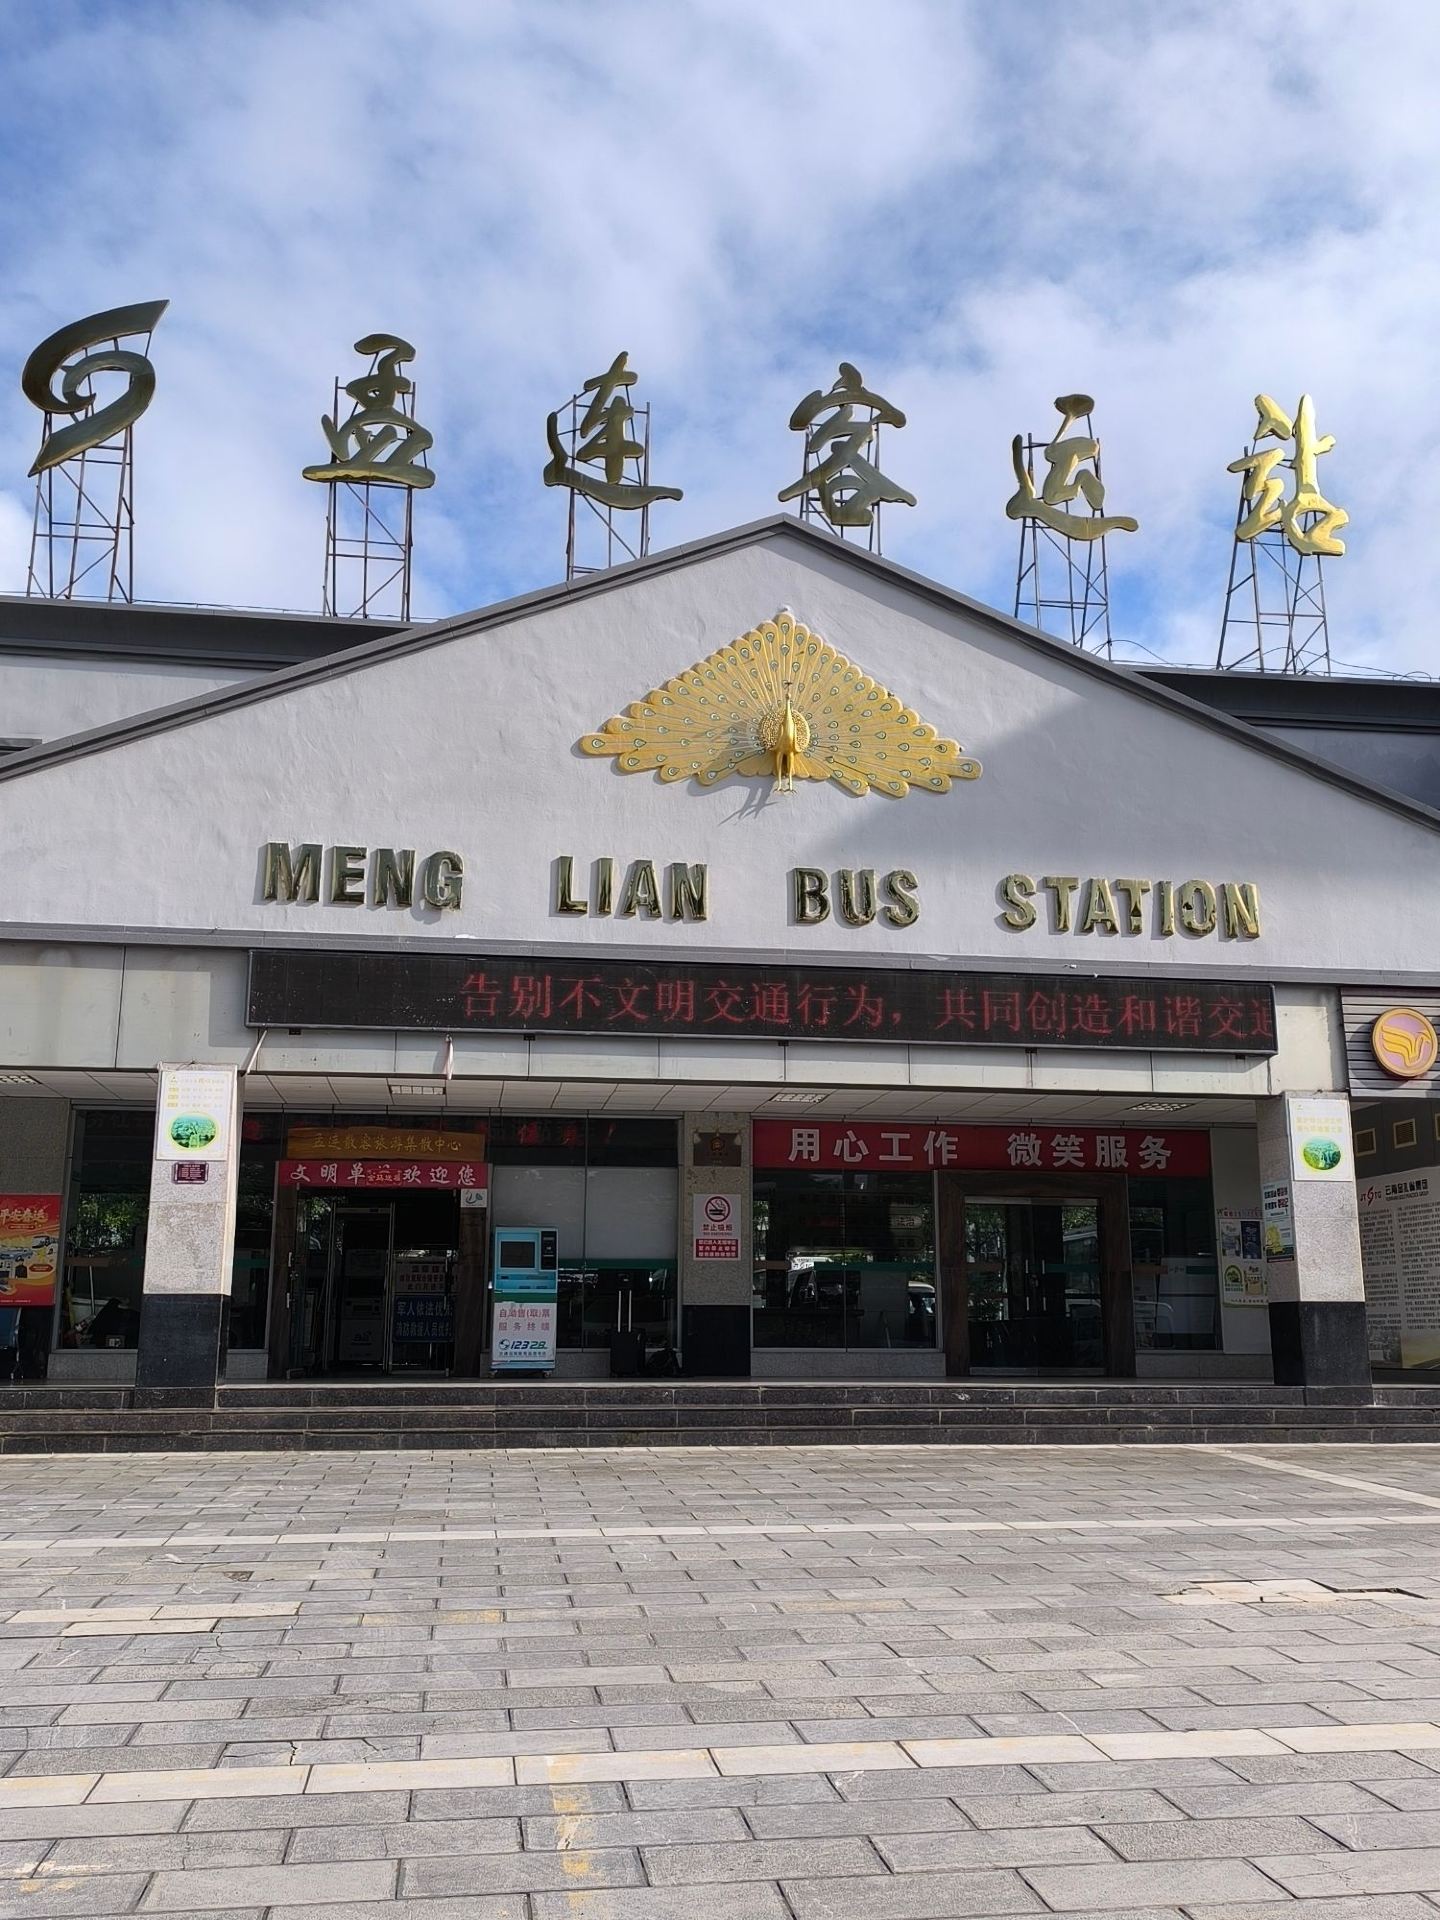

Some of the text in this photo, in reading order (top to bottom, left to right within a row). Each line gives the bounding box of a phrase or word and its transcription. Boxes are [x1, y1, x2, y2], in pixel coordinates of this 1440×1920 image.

[302, 333, 1349, 556] 孟连客运站
[263, 841, 1261, 940] MENG LIAN BUS STATION
[787, 1127, 1173, 1171] 用心工作 微笑服务
[289, 1162, 477, 1186] 文明单欢迎您
[510, 1340, 547, 1350] 12328
